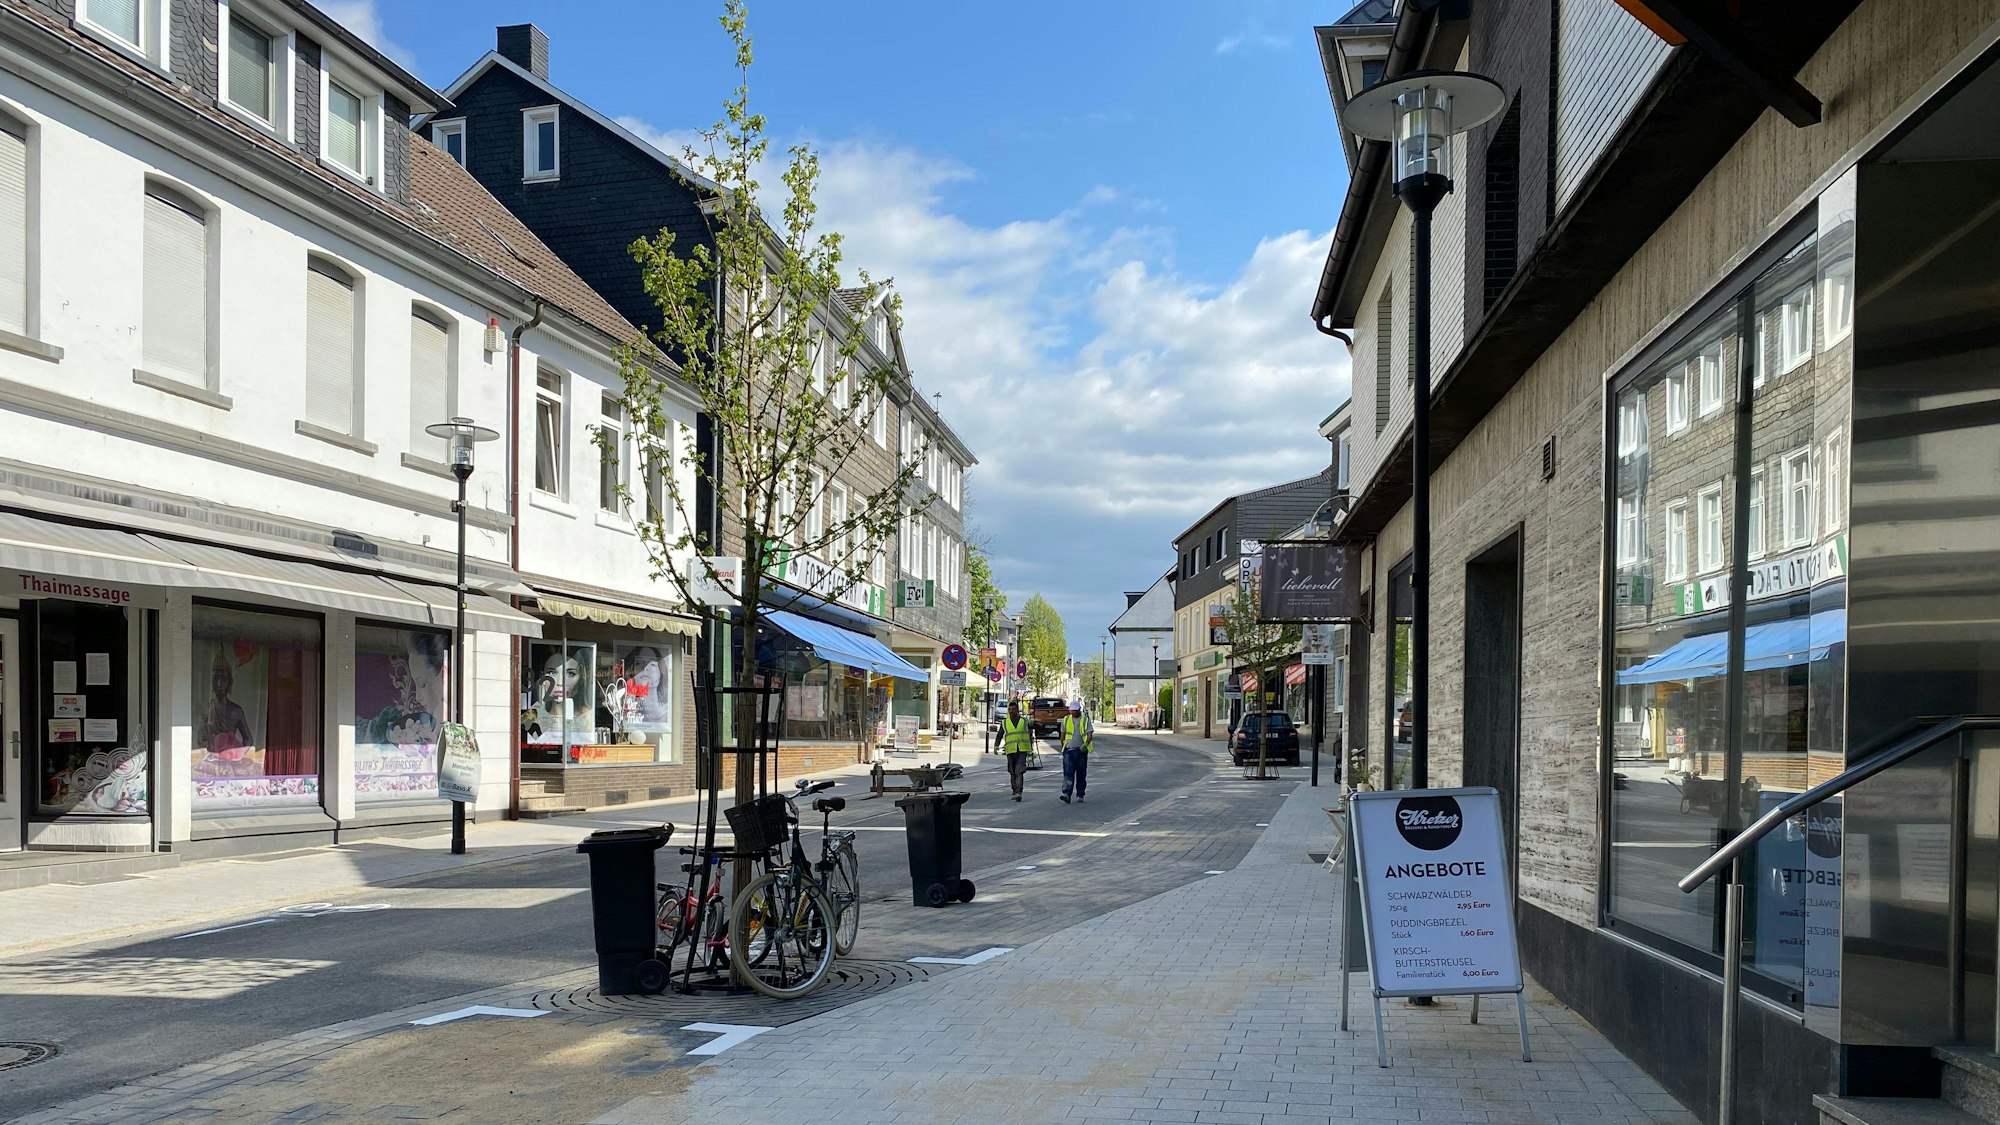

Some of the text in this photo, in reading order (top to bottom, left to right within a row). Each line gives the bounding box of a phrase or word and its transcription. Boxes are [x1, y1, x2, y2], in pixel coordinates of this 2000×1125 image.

[805, 560, 825, 591] FOTO
[19, 574, 131, 604] Thaimassage
[1385, 862, 1486, 878] ANGEBOTE
[1387, 889, 1472, 901] SCHWARZWÄLDER
[1390, 918, 1467, 928] PUDDINGBREZEL
[1391, 931, 1412, 939] Stück
[1394, 946, 1431, 956] KIRSCH-
[1395, 958, 1476, 968] BUTTERSTREUSEL
[1397, 968, 1499, 979] Familienstück 6,00 Euro
